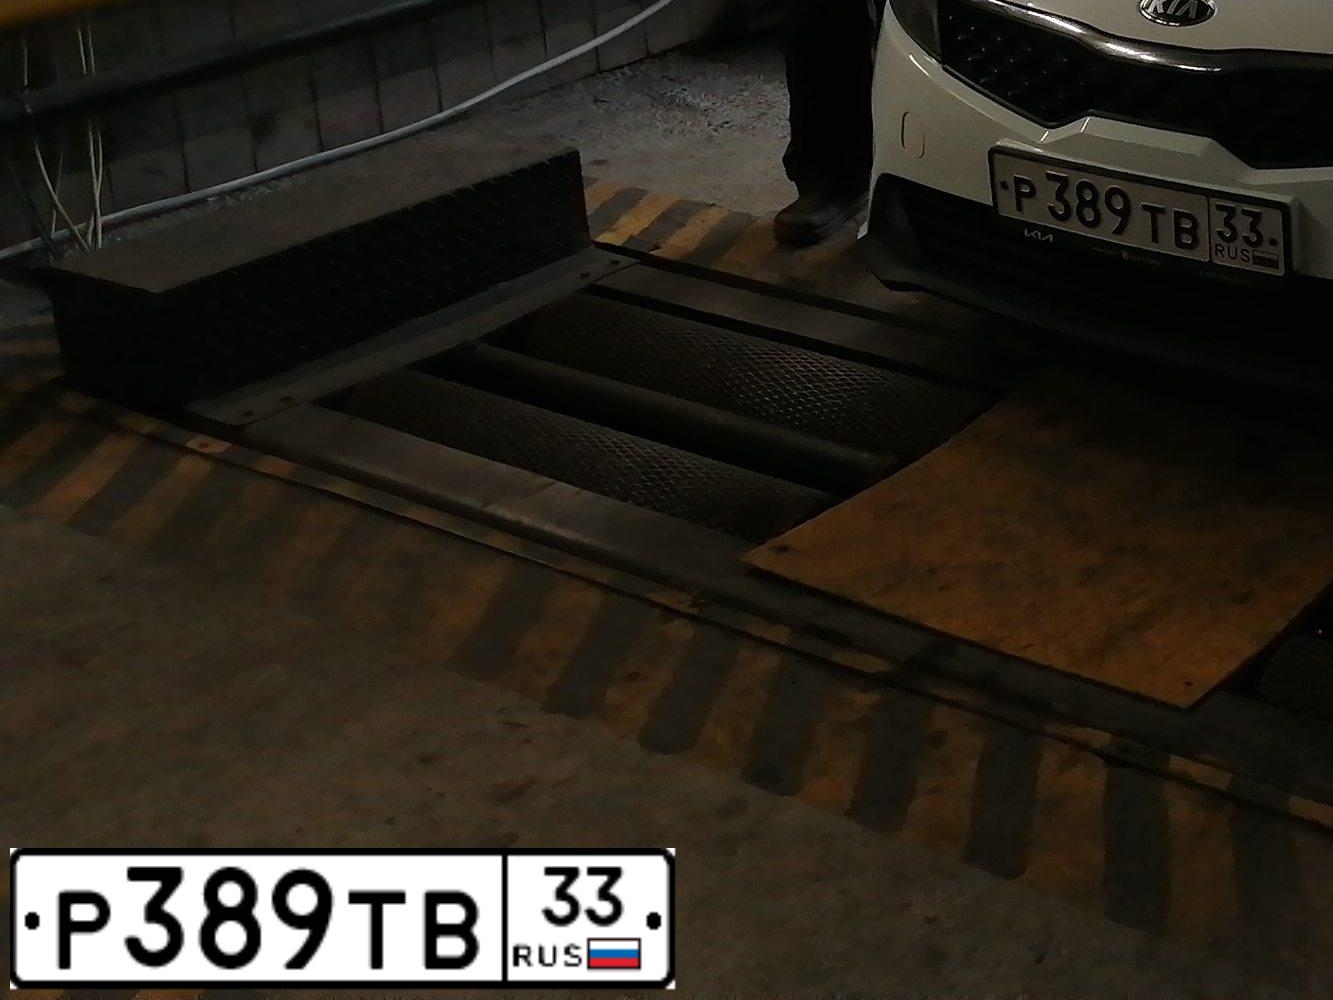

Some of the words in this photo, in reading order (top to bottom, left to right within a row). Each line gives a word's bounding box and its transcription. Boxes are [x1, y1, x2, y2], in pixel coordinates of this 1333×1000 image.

[1013, 170, 1200, 250] Р389ТВ
[1215, 203, 1264, 247] 33
[1215, 243, 1250, 263] RUS
